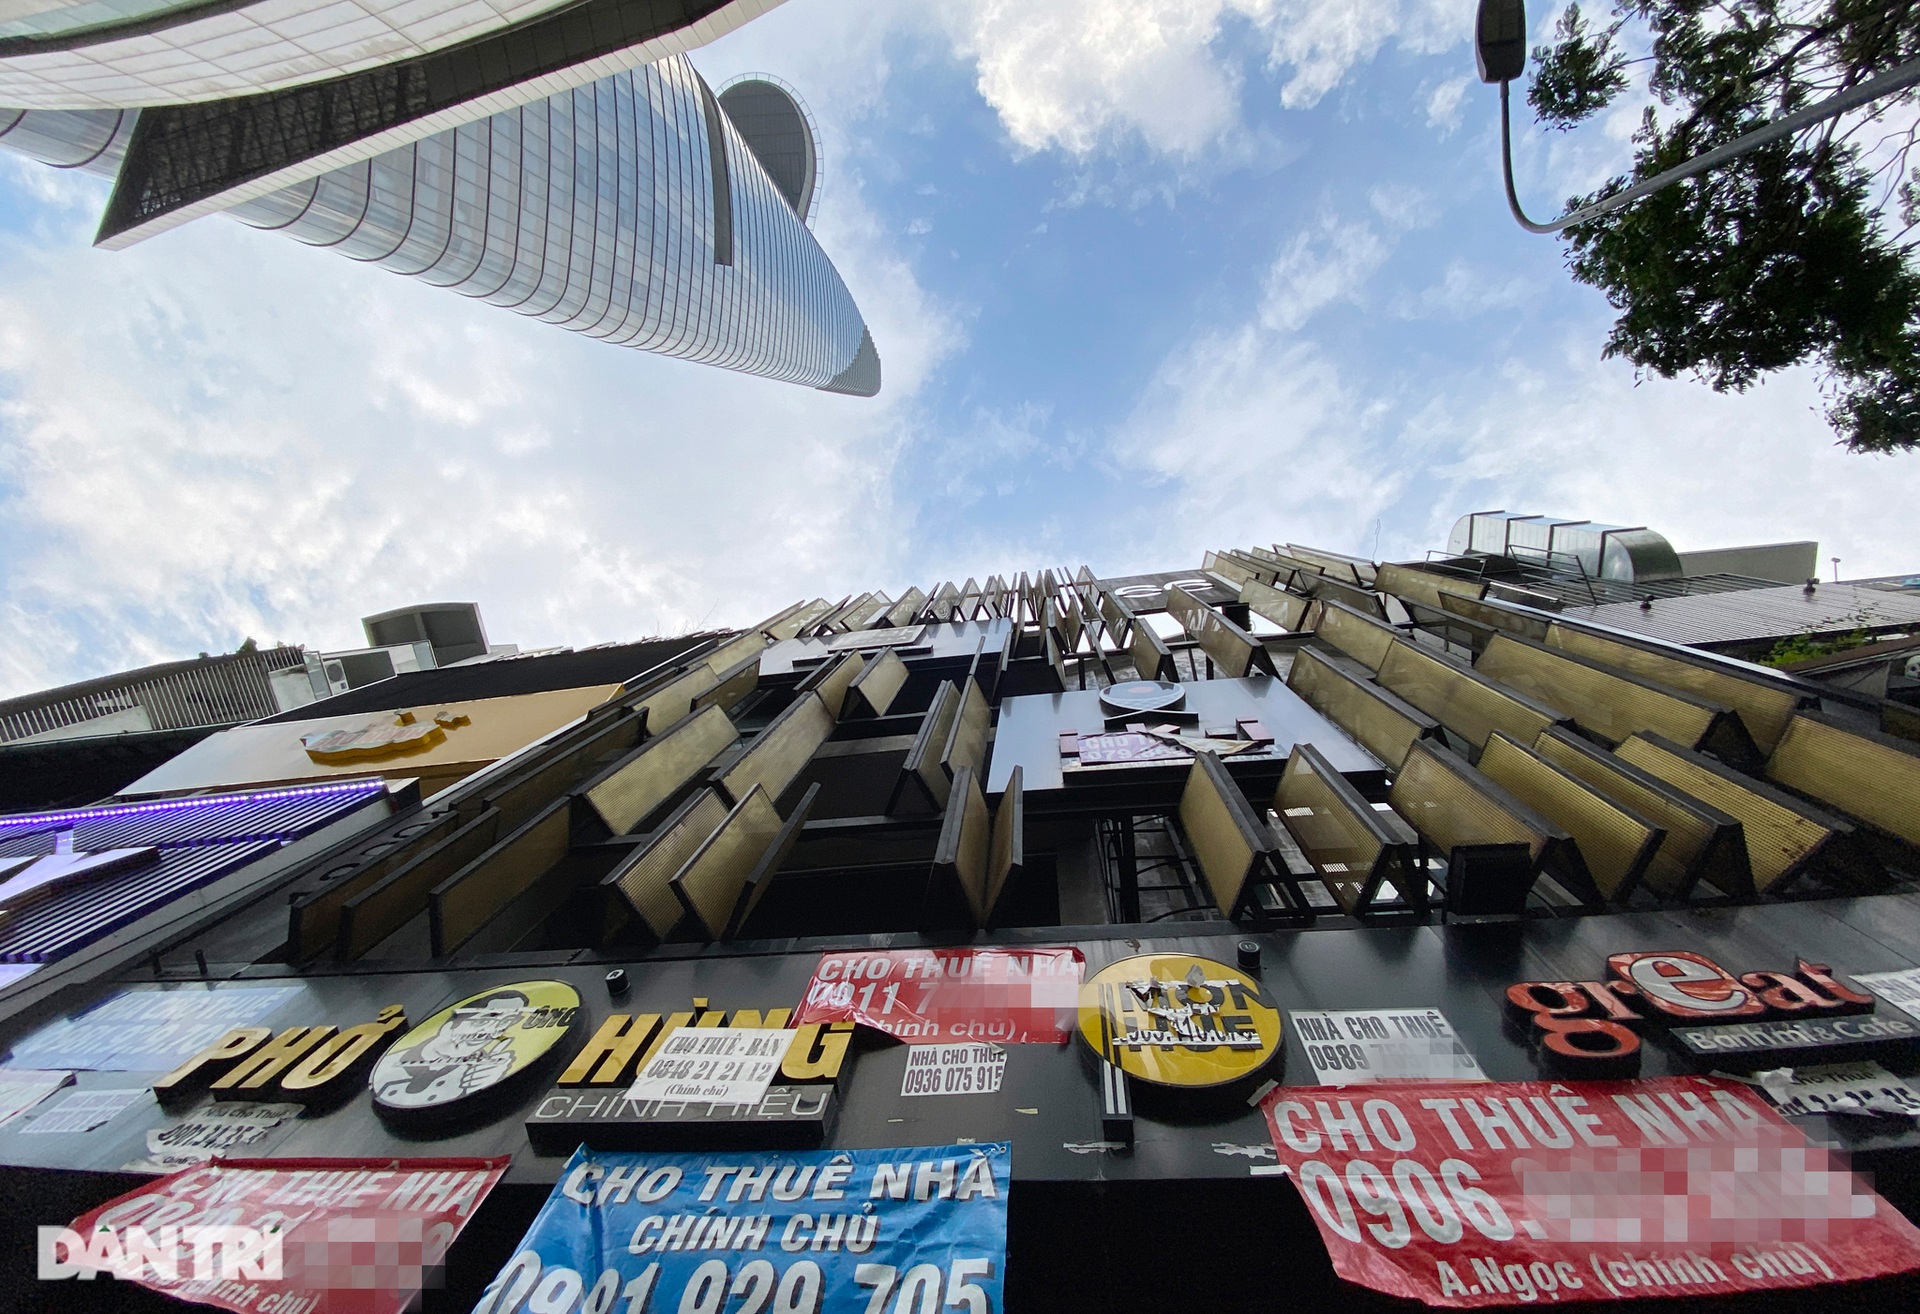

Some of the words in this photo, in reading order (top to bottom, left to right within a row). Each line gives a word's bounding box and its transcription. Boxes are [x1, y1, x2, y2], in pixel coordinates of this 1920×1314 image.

[819, 958, 891, 981] CHO
[1505, 950, 1875, 1058] great
[950, 1017, 1017, 1041] chủ)
[1296, 1013, 1344, 1042] NHÀ
[1345, 1016, 1390, 1040] CHO
[1388, 1011, 1453, 1039] THUÊ
[152, 1004, 408, 1090] PHỞ
[664, 1036, 698, 1055] CHO
[698, 1032, 741, 1055] THUÊ
[745, 1033, 783, 1056] BÁN
[910, 1047, 937, 1067] NHÀ
[942, 1048, 968, 1065] CHO
[1307, 1044, 1371, 1071] 0989
[691, 1061, 719, 1080] 21
[718, 1061, 744, 1081] 21
[747, 1062, 772, 1082] 12
[905, 1068, 942, 1094] 0936
[945, 1066, 972, 1092] 075
[664, 1083, 701, 1097] (Chính
[1274, 1099, 1416, 1153] CHO
[1419, 1083, 1622, 1150] THUÊ
[562, 1161, 682, 1204] CHO
[698, 1154, 854, 1202] THUÊ
[869, 1148, 996, 1200] NHÀ
[628, 1205, 772, 1256] CHÍNH
[780, 1201, 879, 1252] CHỦ
[1437, 1256, 1584, 1302] A.Ngọc
[1588, 1251, 1727, 1298] (chính
[1730, 1241, 1835, 1280] chủ)
